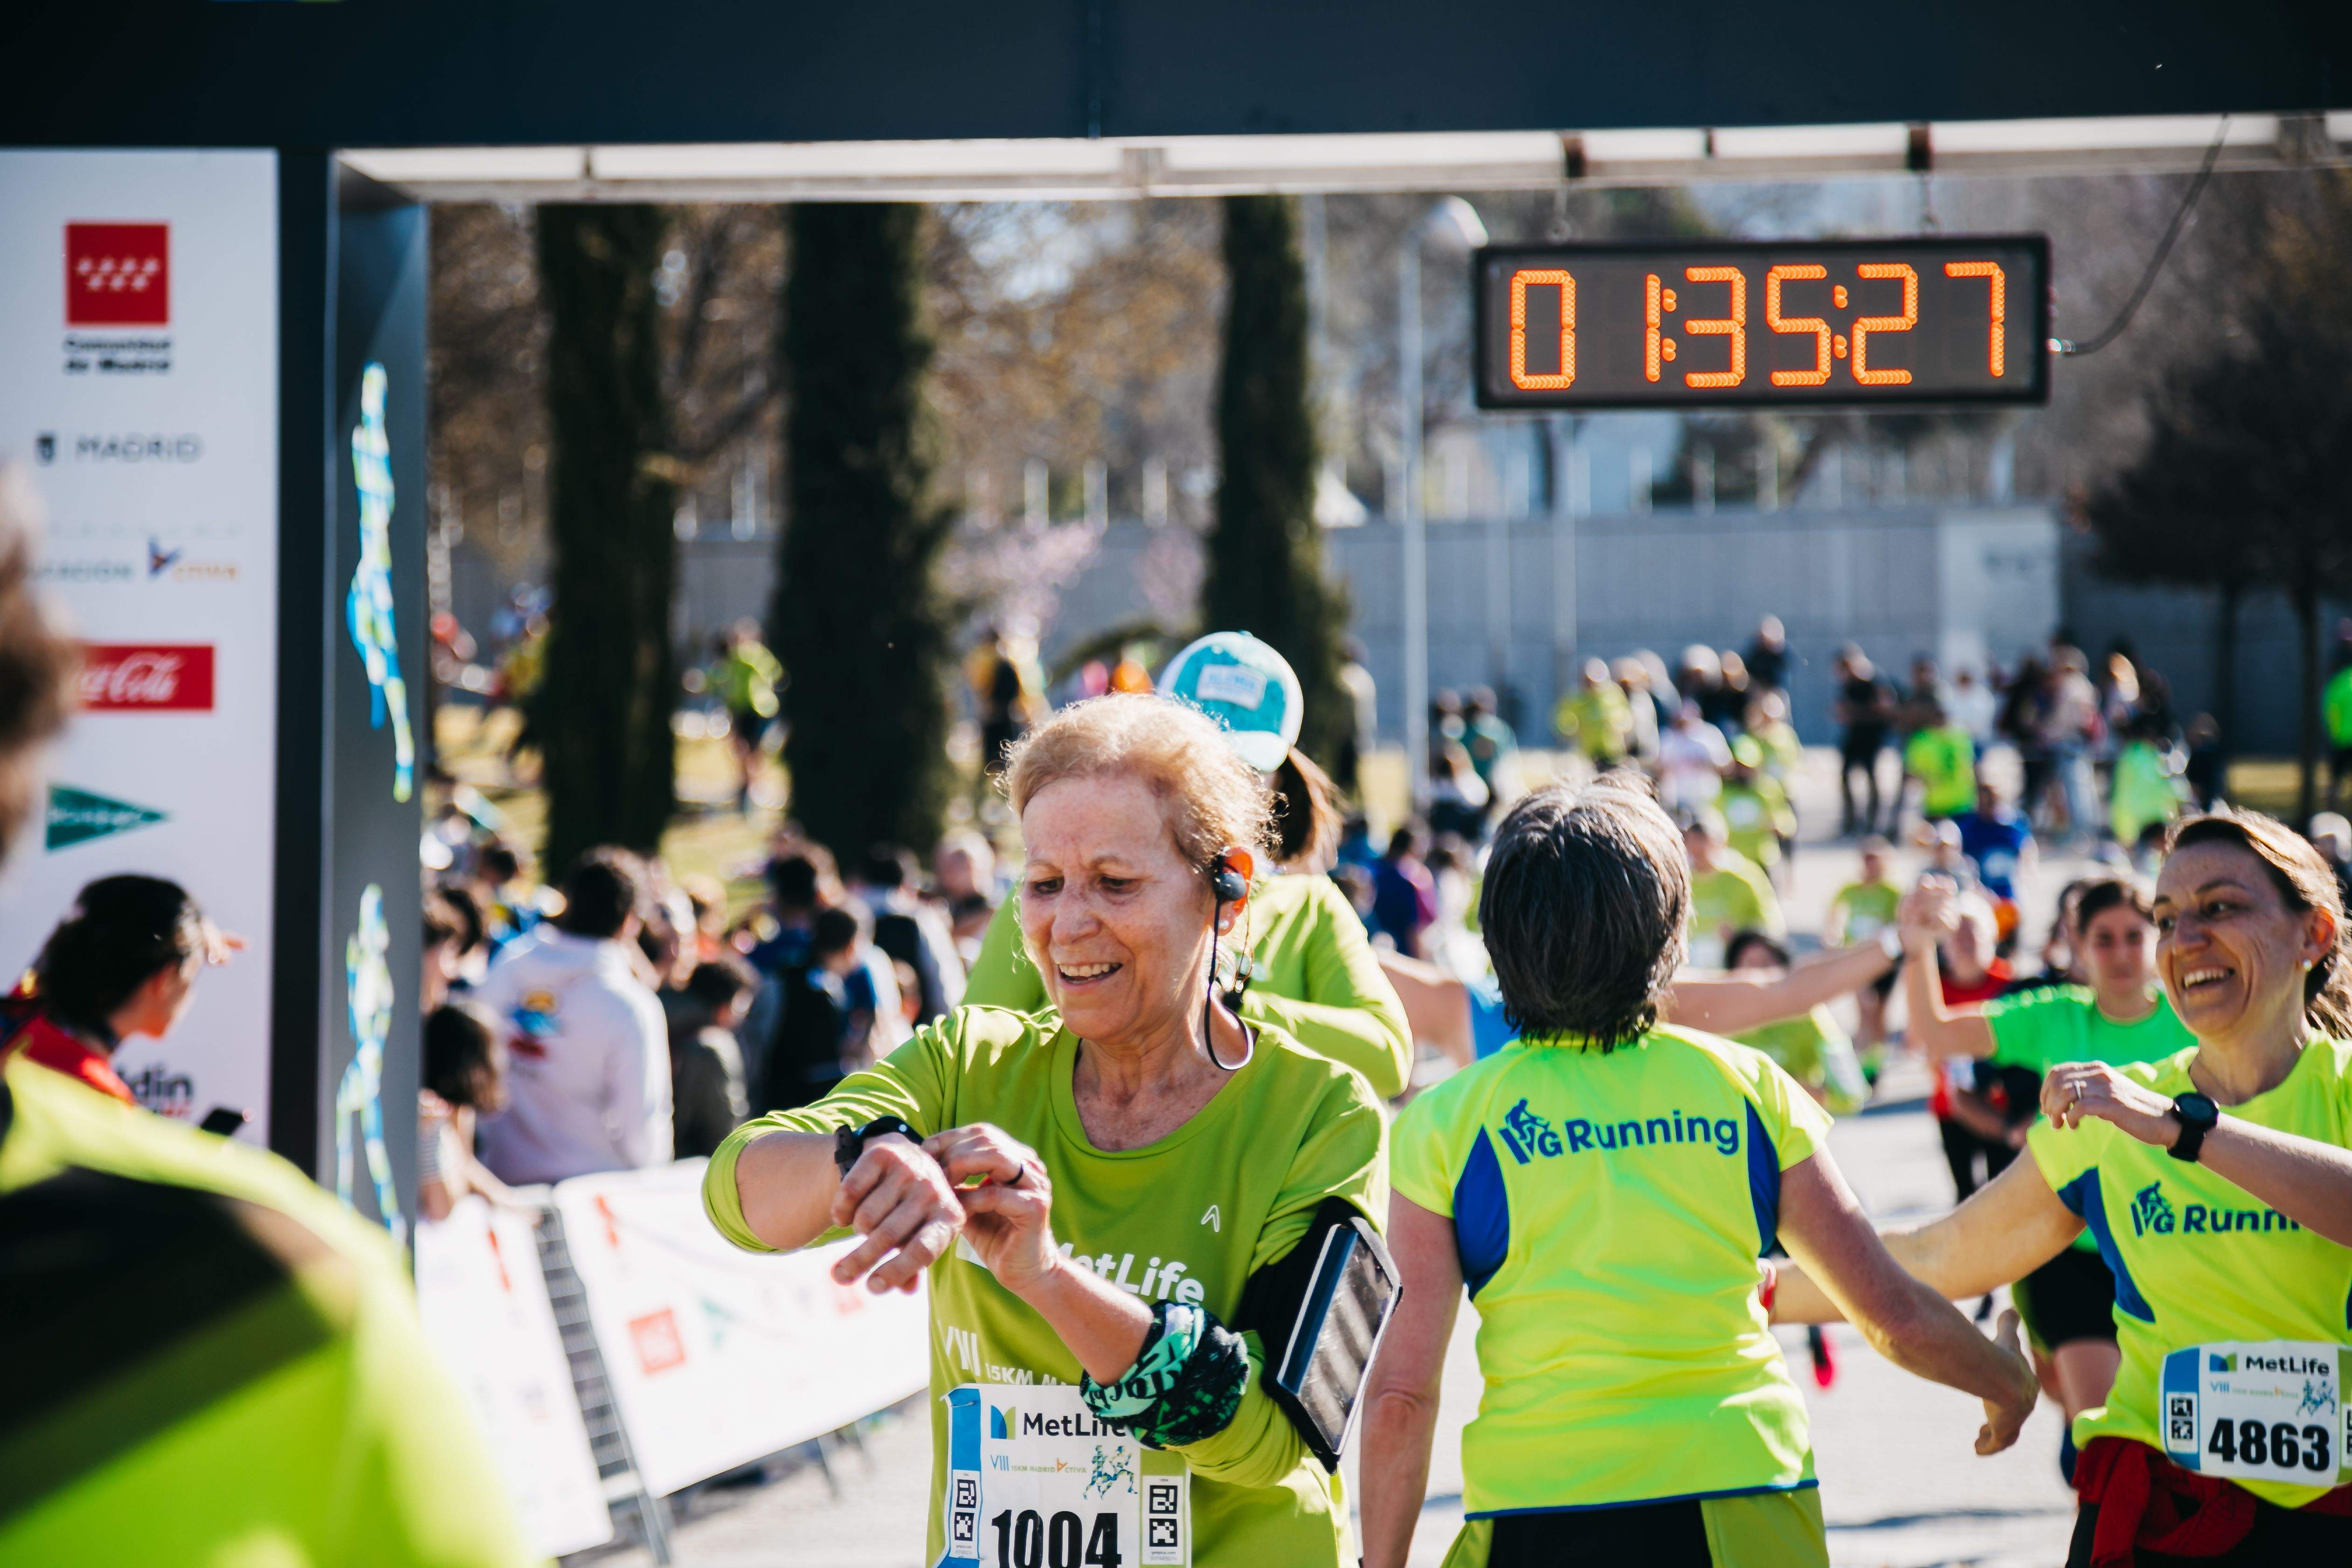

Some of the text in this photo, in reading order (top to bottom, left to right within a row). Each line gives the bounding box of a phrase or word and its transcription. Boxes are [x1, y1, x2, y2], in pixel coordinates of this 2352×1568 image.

[76, 434, 202, 462] MADRID
[1564, 1110, 1739, 1155] Running
[2184, 1204, 2300, 1233] Runn
[1058, 1242, 1204, 1307] etLife
[985, 1363, 1034, 1385] 15KM
[2246, 1355, 2330, 1376] MetLife
[2208, 1417, 2330, 1472] 4863
[990, 1455, 1009, 1471] VIII
[991, 1509, 1122, 1568] 1004
